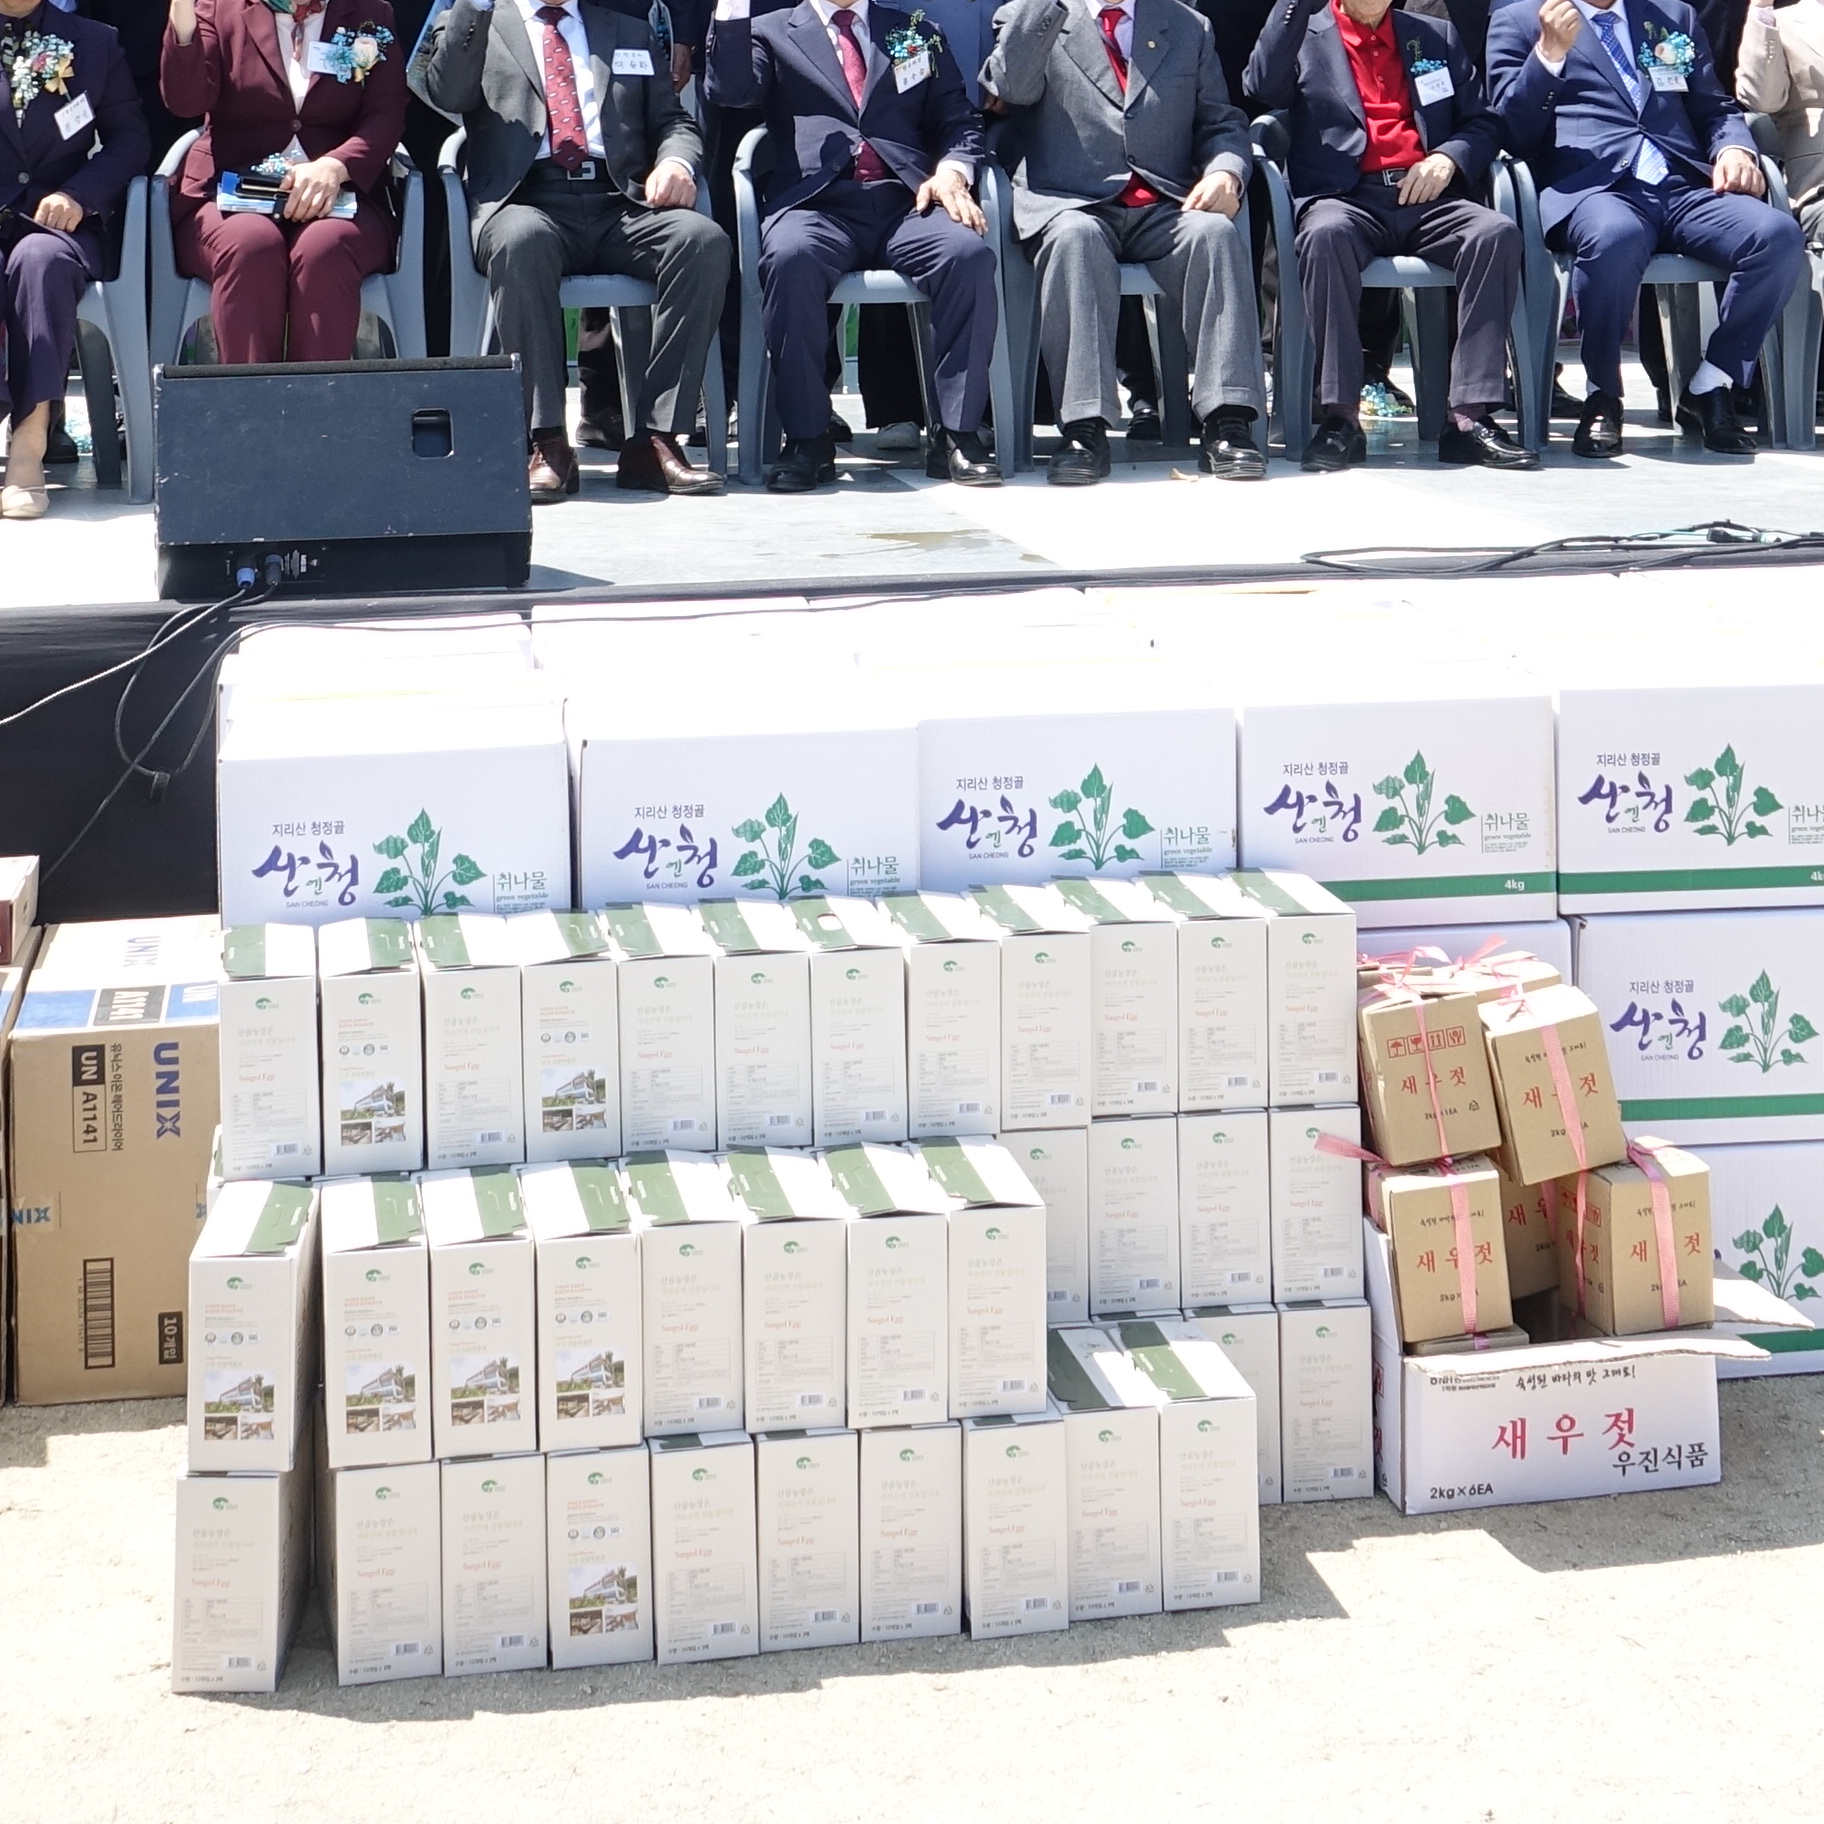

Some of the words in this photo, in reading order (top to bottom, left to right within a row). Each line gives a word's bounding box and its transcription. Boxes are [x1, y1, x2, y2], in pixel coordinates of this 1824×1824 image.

[1283, 763, 1314, 776] 지리산
[1318, 762, 1349, 775] 청정골
[1597, 754, 1626, 767] 지리산
[1630, 753, 1660, 766] 청정골
[956, 778, 988, 791] 지리산
[992, 776, 1024, 790] 청정골
[634, 806, 667, 819] 지리산
[671, 805, 705, 818] 청정골
[1484, 813, 1530, 831] 취나물
[272, 822, 306, 837] 지리산
[311, 821, 345, 836] 청정골
[1164, 827, 1211, 847] 취나물
[851, 856, 899, 876] 취나물
[497, 870, 546, 891] 취나물
[1505, 879, 1524, 891] 4kg
[124, 936, 161, 968] UNIX
[1630, 981, 1660, 994] 지리산
[1664, 980, 1694, 993] 청정골
[81, 1051, 98, 1081] UN
[153, 1042, 181, 1139] UNIX
[81, 1091, 98, 1143] A1141
[164, 1316, 177, 1360] 10개입
[1612, 1442, 1708, 1476] 우진식품
